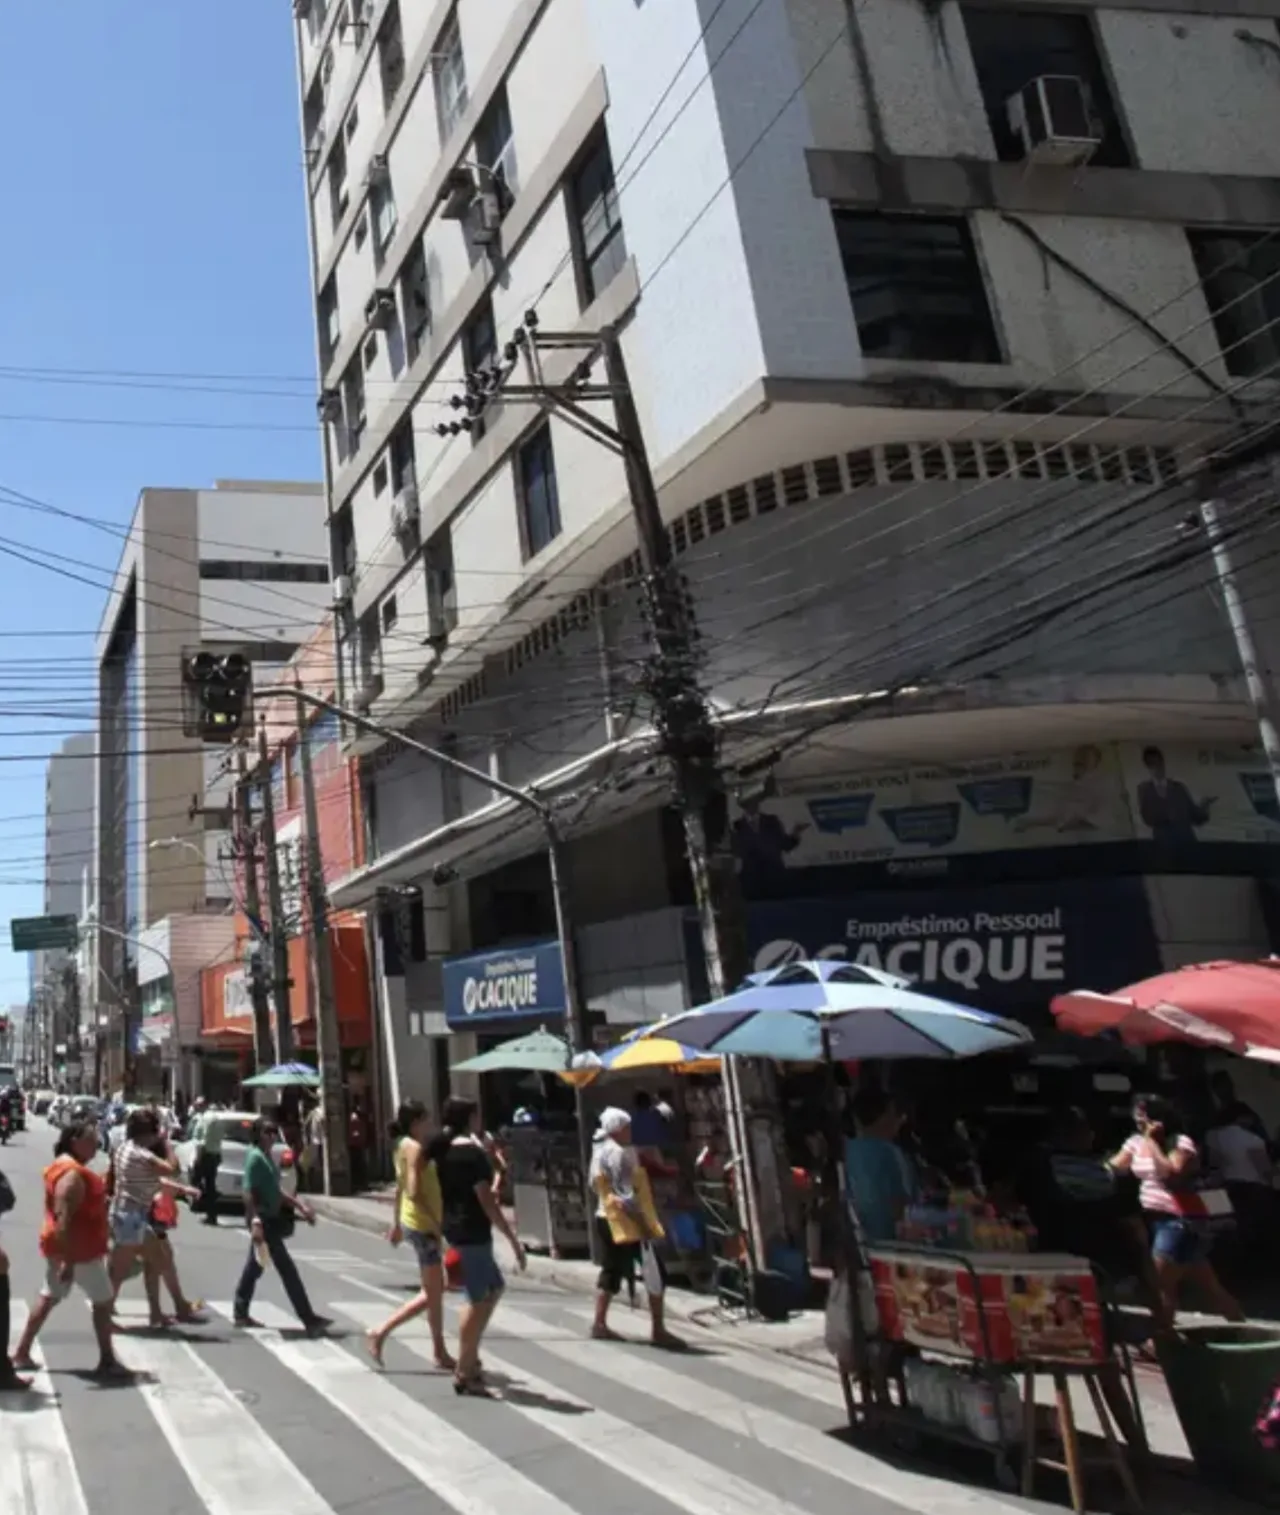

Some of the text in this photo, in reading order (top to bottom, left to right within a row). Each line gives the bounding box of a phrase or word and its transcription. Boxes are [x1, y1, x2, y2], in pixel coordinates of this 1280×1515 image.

[845, 908, 1061, 942] Empréstimo Pessoal
[478, 972, 538, 1012] CACIQUE
